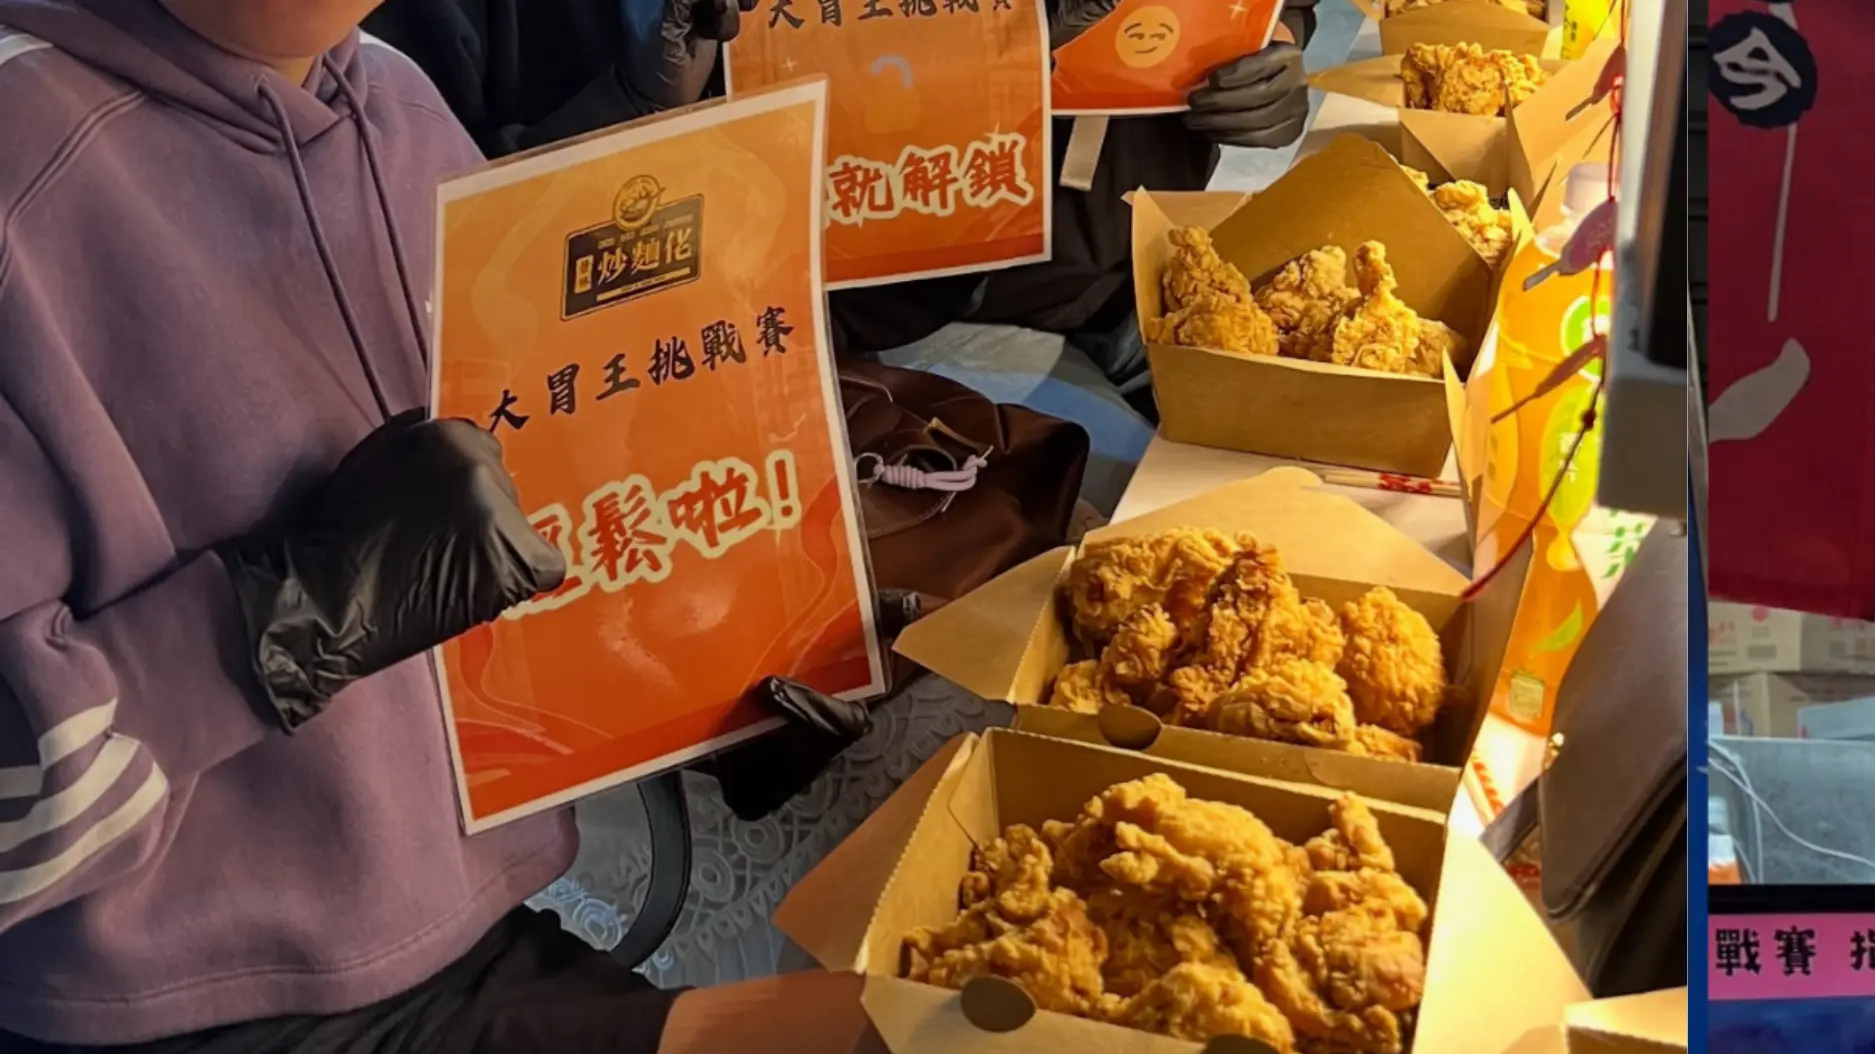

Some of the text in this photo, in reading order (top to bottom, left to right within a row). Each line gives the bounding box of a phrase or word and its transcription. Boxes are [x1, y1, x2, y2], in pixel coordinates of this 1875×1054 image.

[826, 139, 1028, 219] 就解鎖
[488, 305, 796, 434] 大胃王挑戰賽
[1714, 925, 1818, 976] 戰賽
